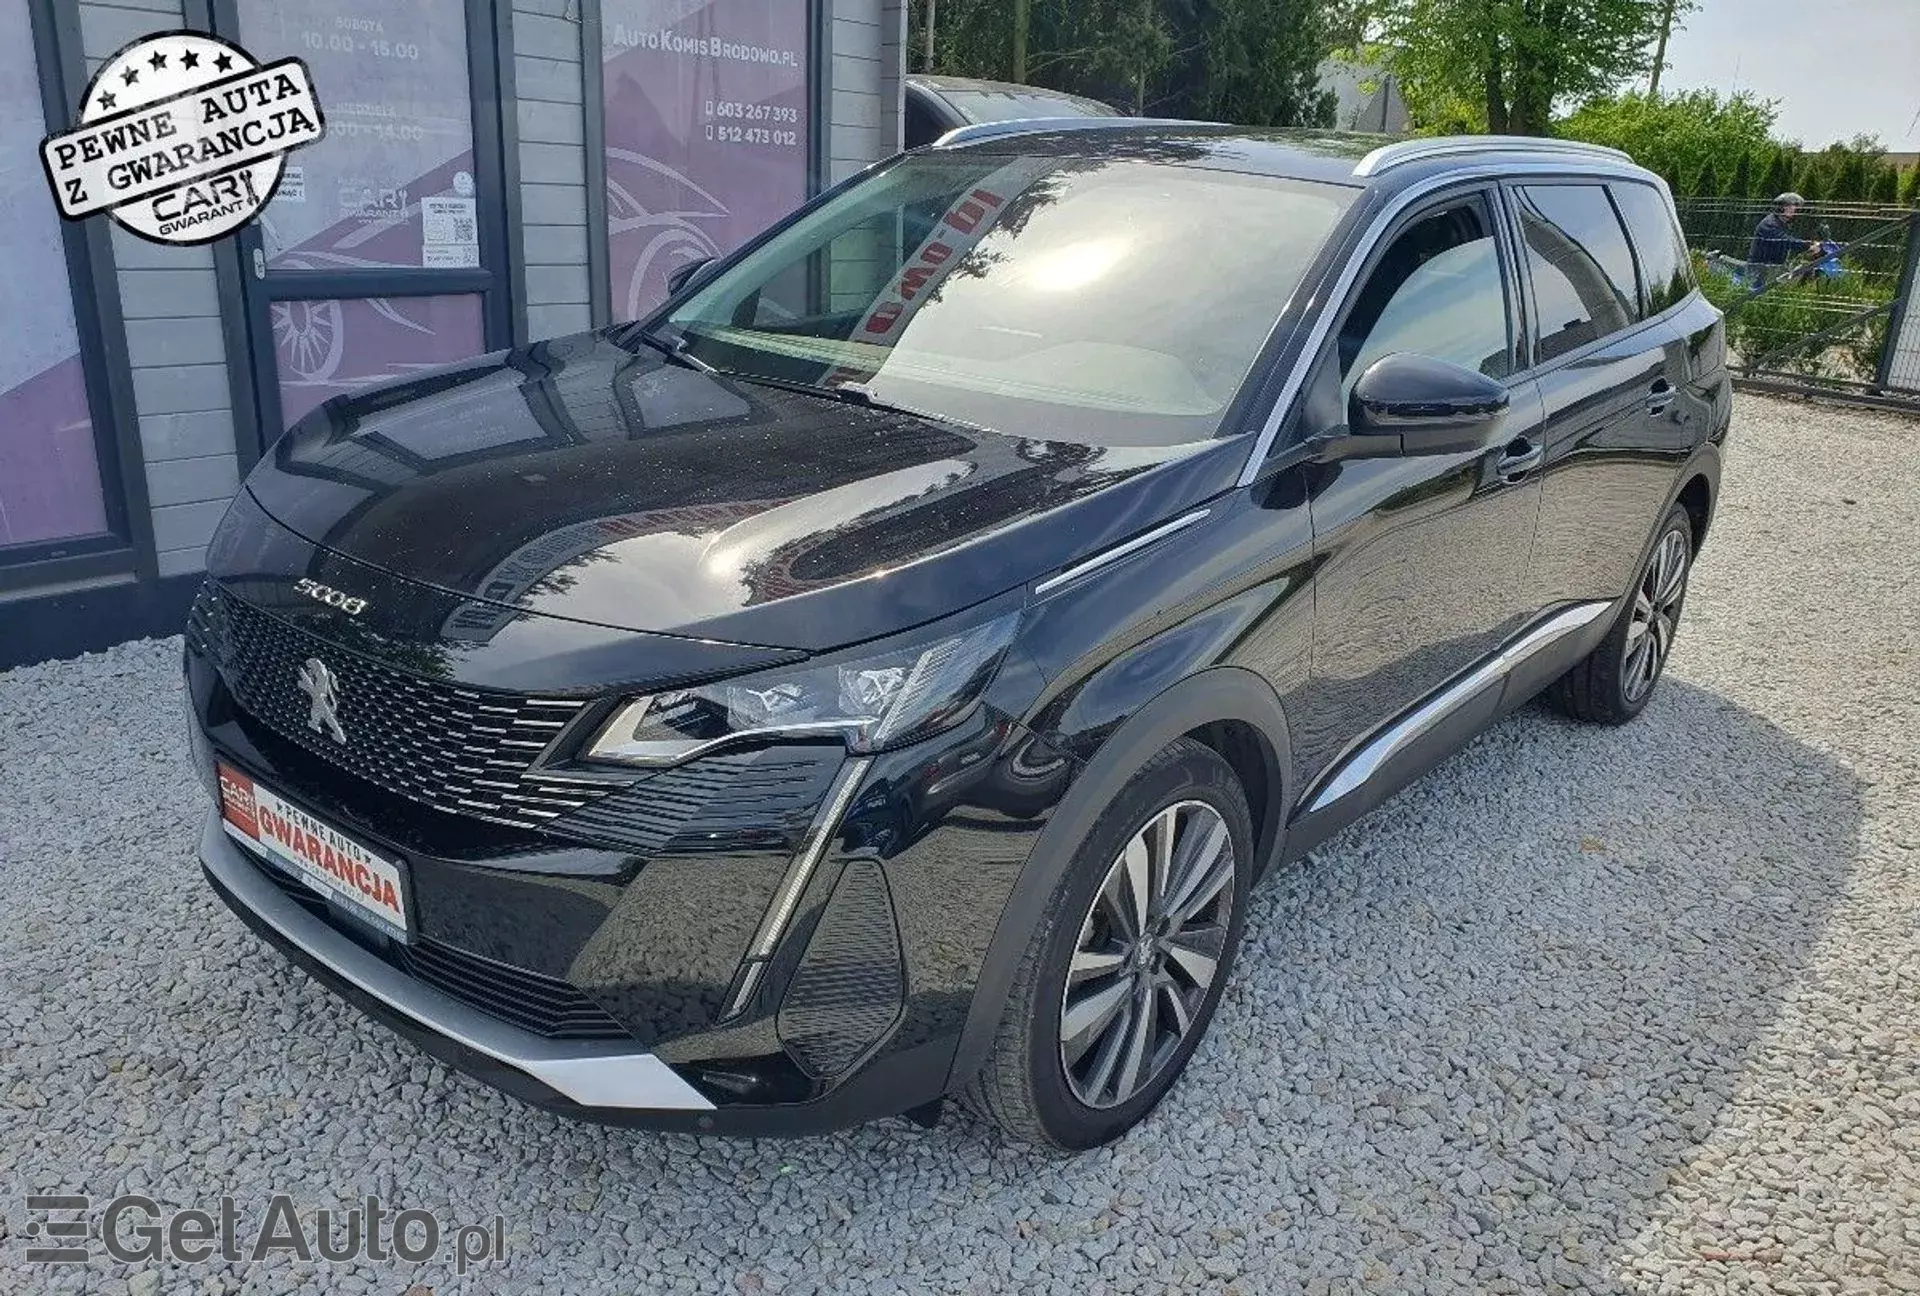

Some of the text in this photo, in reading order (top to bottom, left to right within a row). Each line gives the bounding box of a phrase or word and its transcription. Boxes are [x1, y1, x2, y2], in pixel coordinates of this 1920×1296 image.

[301, 31, 353, 52] 10.00
[717, 101, 798, 122] 603 267 393
[718, 126, 797, 145] 512 473 012
[293, 578, 367, 615] 5008
[286, 804, 326, 841] PEWNE
[329, 834, 362, 860] AUTO
[258, 805, 401, 913] GWARANCJA
